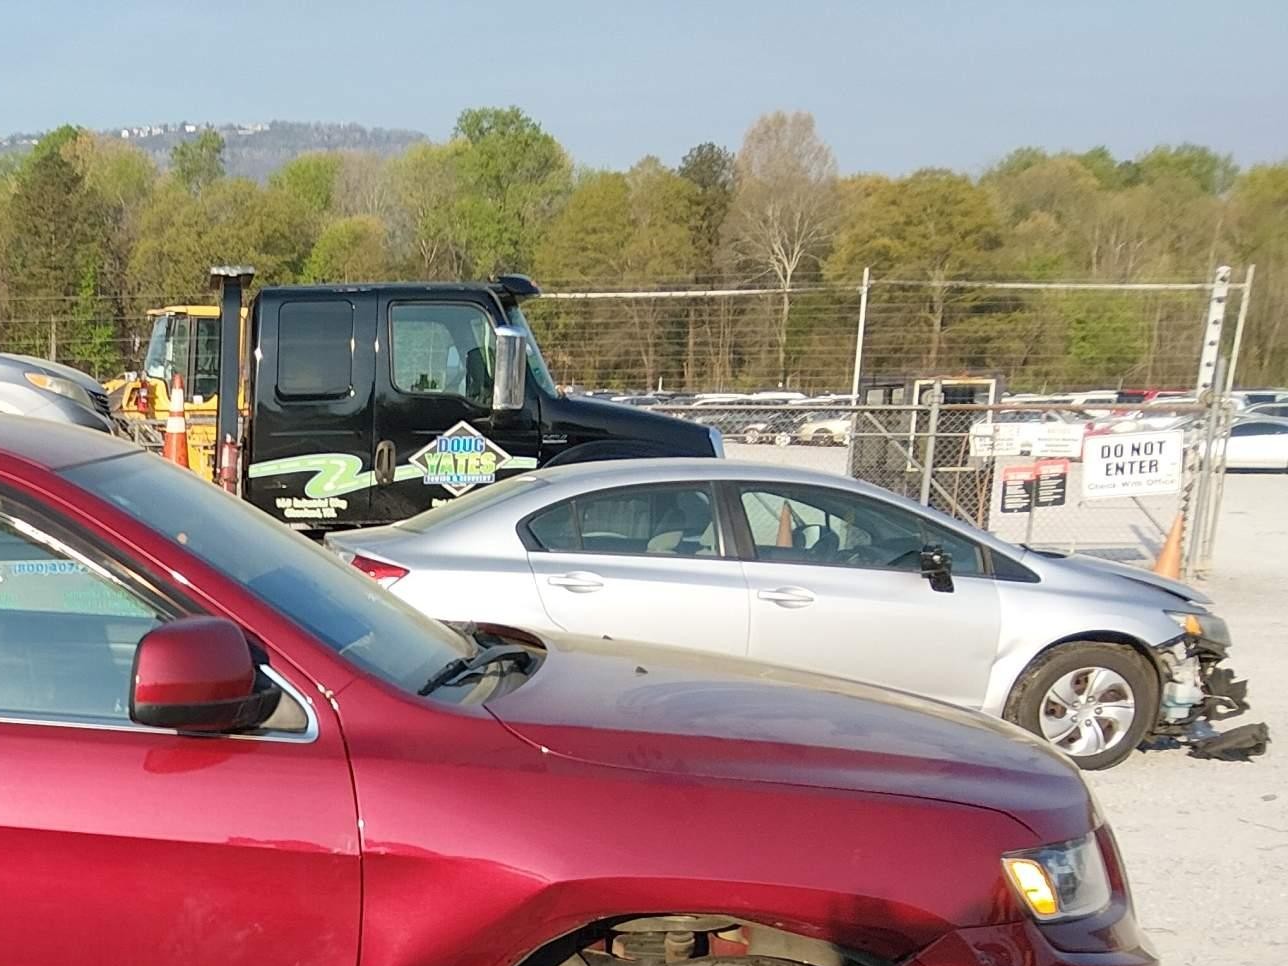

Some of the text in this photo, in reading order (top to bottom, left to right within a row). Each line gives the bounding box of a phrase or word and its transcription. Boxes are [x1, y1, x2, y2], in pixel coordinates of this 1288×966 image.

[438, 436, 485, 452] DOUG
[1101, 440, 1166, 459] DO NOT
[425, 452, 497, 475] YATES
[1105, 459, 1158, 476] ENTER
